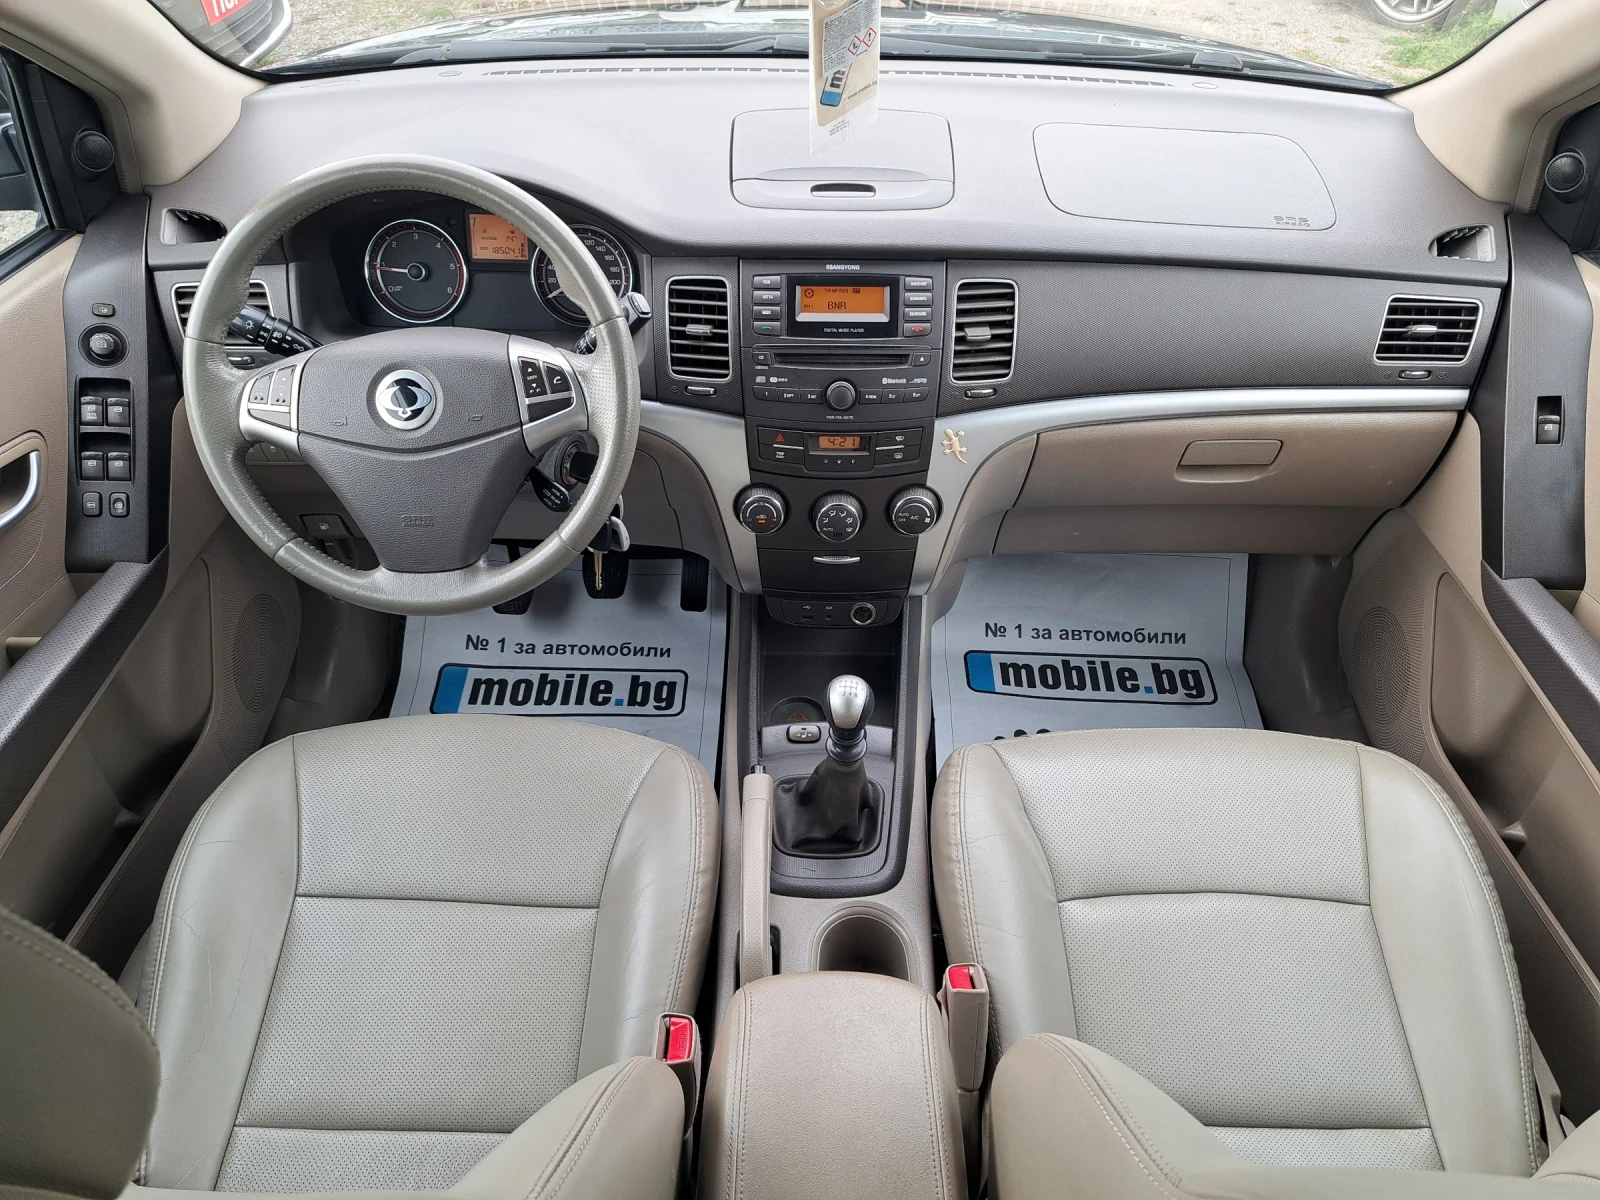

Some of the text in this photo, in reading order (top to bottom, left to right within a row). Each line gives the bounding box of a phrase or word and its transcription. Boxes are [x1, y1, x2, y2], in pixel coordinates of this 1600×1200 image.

[447, 286, 453, 294] 6
[827, 301, 847, 311] BNR
[827, 437, 856, 447] 4:21
[984, 622, 1186, 645] № 1 за автомобили
[465, 634, 671, 658] № 1 за автомобили
[999, 659, 1206, 699] mobile.bg
[467, 673, 677, 711] mobile.bg
